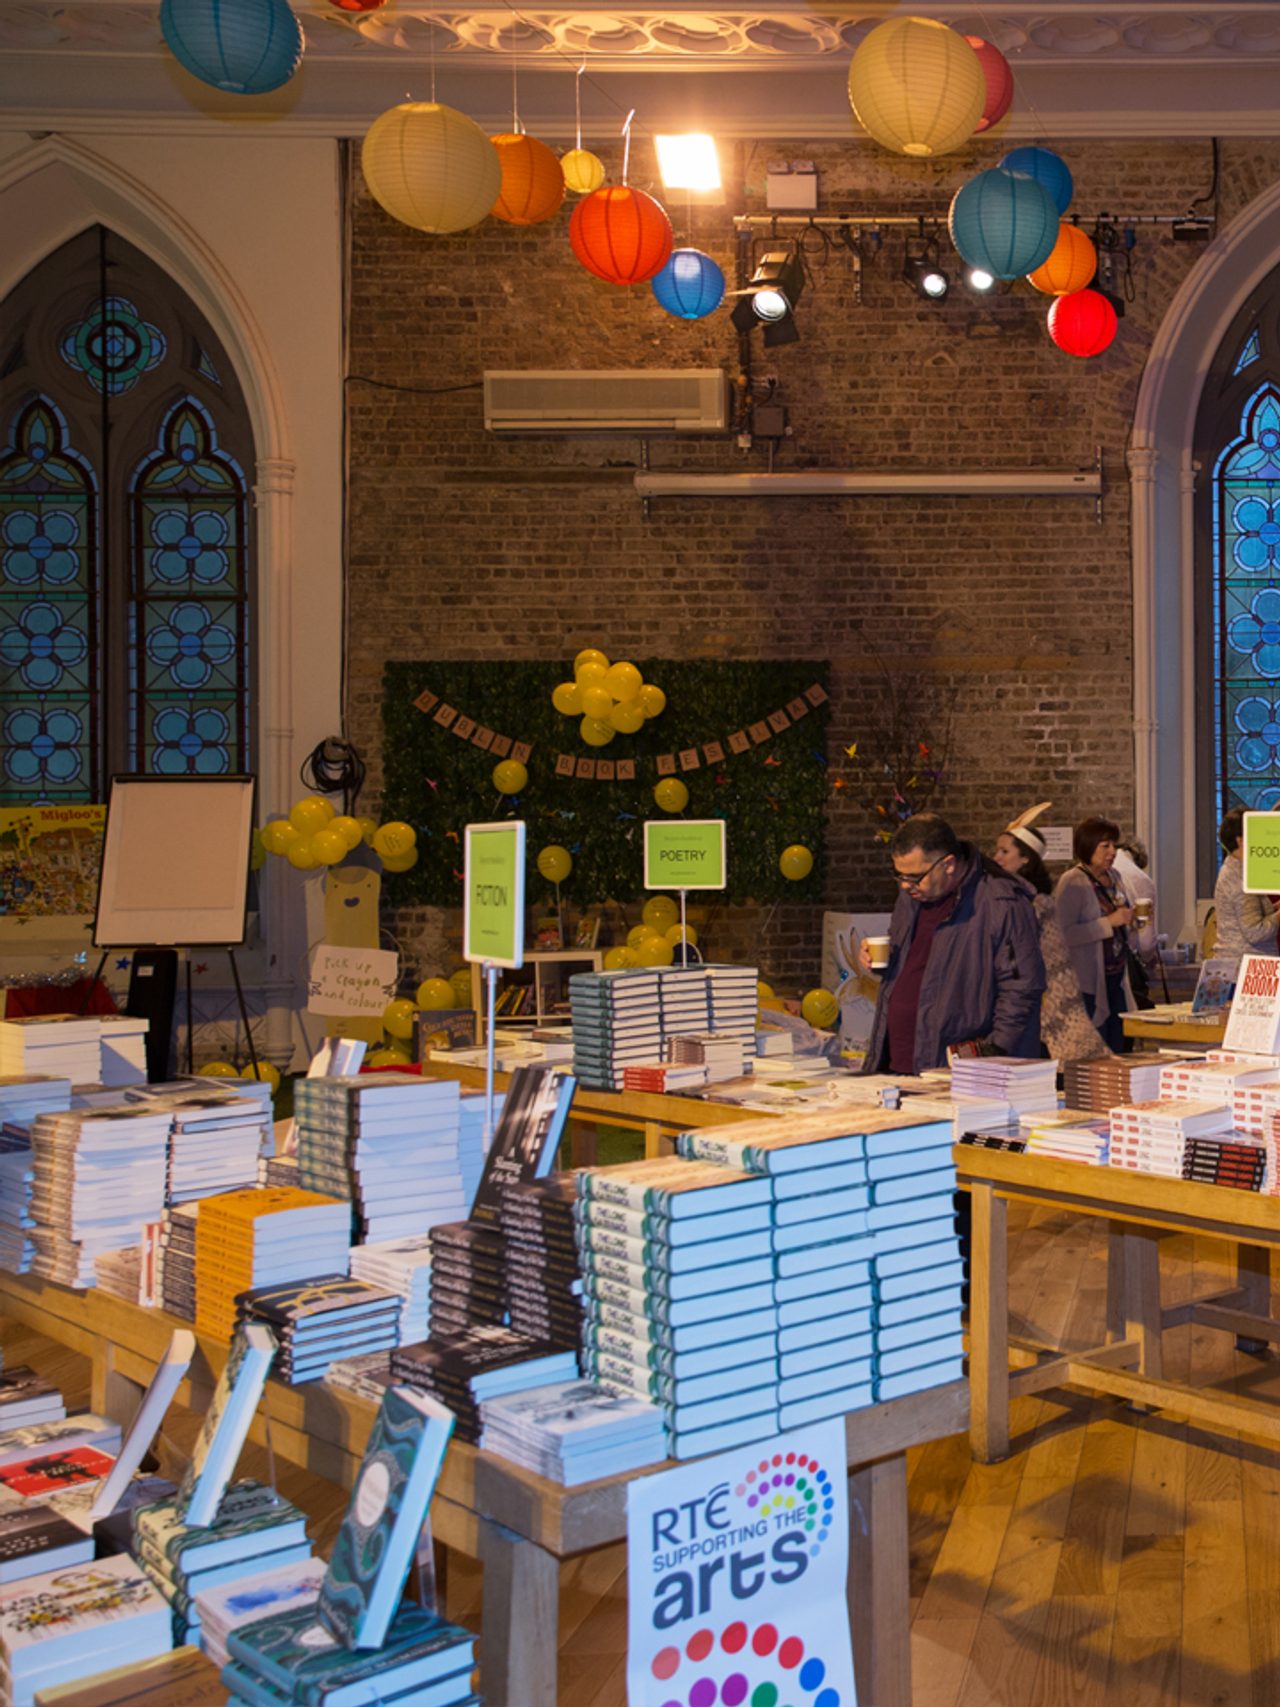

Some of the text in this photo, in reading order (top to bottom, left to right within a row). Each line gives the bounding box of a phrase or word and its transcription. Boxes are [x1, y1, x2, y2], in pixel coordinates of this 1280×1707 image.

[418, 688, 824, 776] DUBLIN BOOK FESTIVAL
[41, 809, 102, 822] Migloo's
[659, 849, 707, 862] POETRY
[1249, 846, 1280, 858] FOOD
[1246, 958, 1280, 977] INSIDE
[1241, 974, 1280, 997] ROOM
[652, 1481, 731, 1552] RTÉ
[653, 1505, 807, 1573] SUPPORTING THE
[652, 1530, 809, 1630] arts
